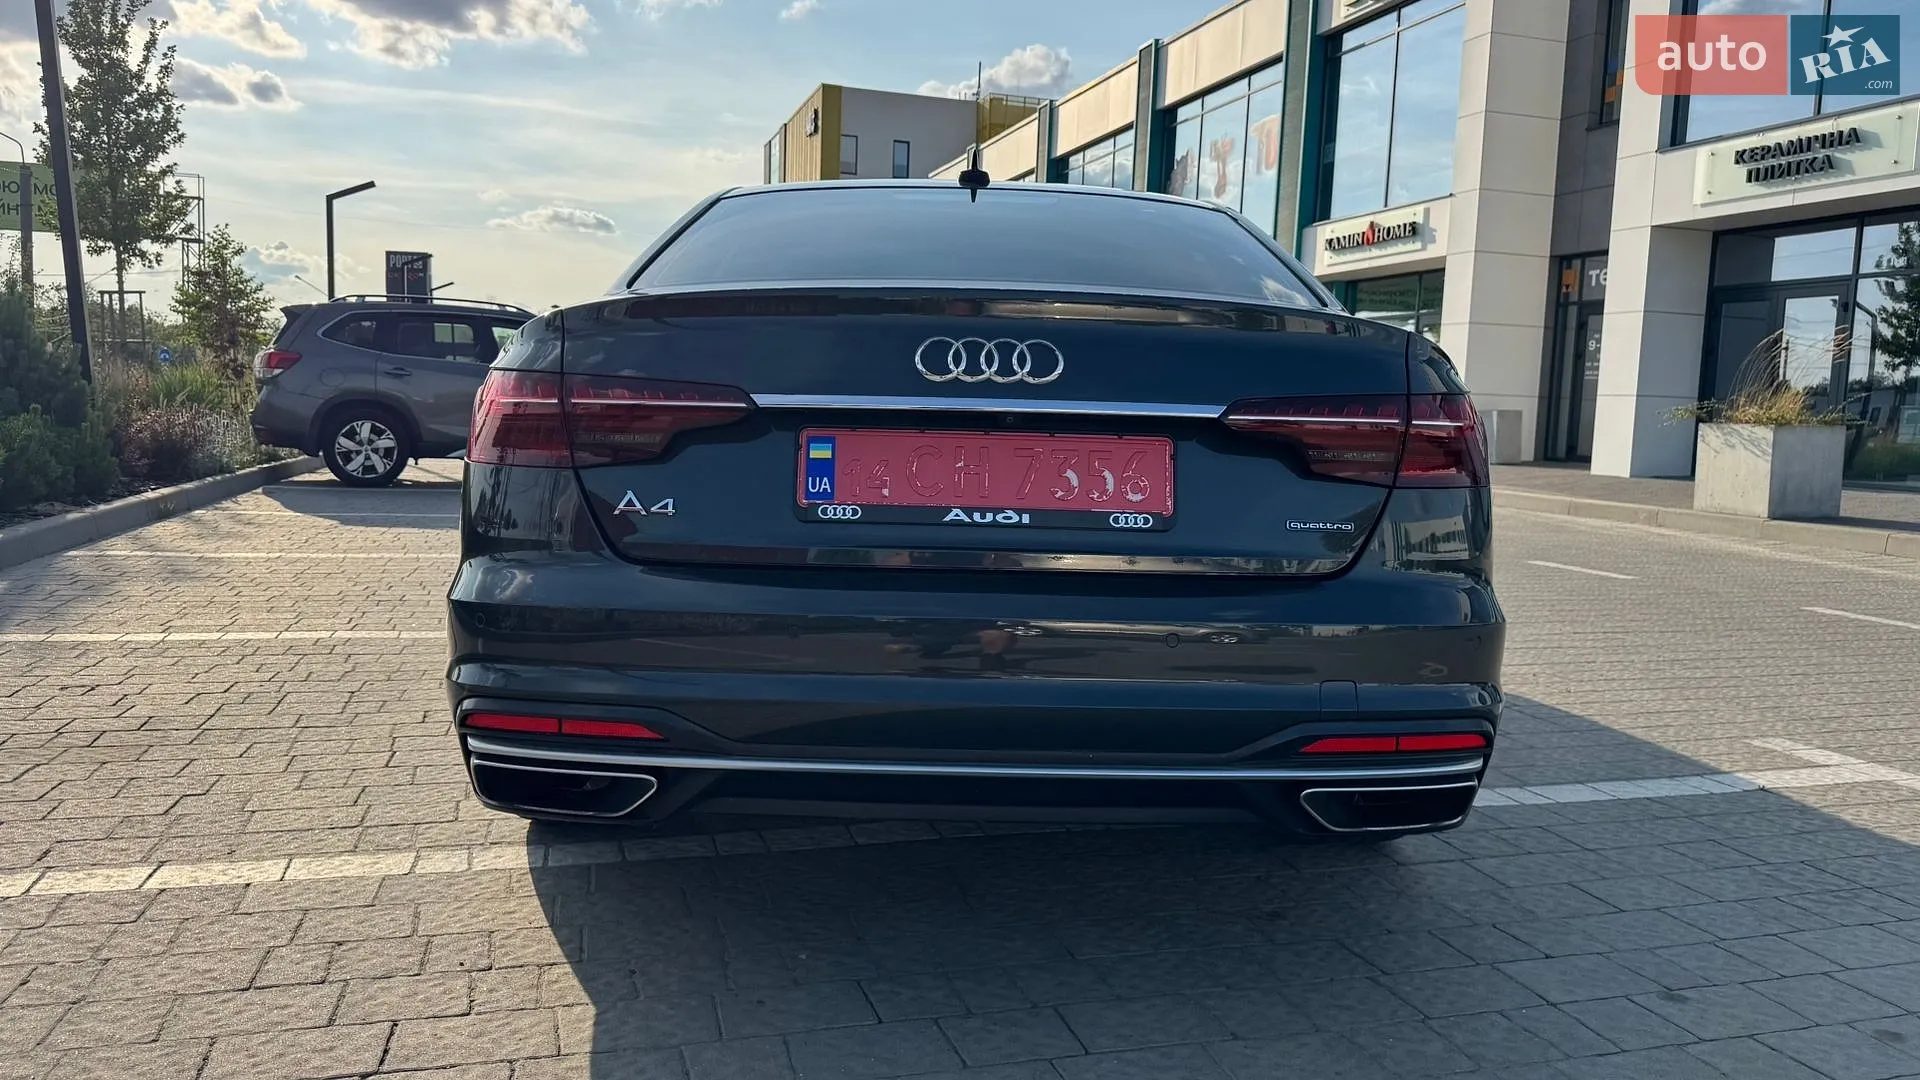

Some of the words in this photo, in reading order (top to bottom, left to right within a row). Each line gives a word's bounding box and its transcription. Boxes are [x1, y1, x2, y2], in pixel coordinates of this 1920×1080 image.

[1733, 127, 1861, 165] КЕРАМІЧНА
[1746, 154, 1835, 183] ПЛИТКА
[1324, 231, 1366, 251] KAMIN
[1374, 221, 1417, 243] HOME
[808, 475, 832, 493] UA
[1013, 448, 1151, 503] 7356
[612, 489, 676, 516] A4
[941, 508, 1030, 524] Audi
[1289, 521, 1352, 531] quattro
